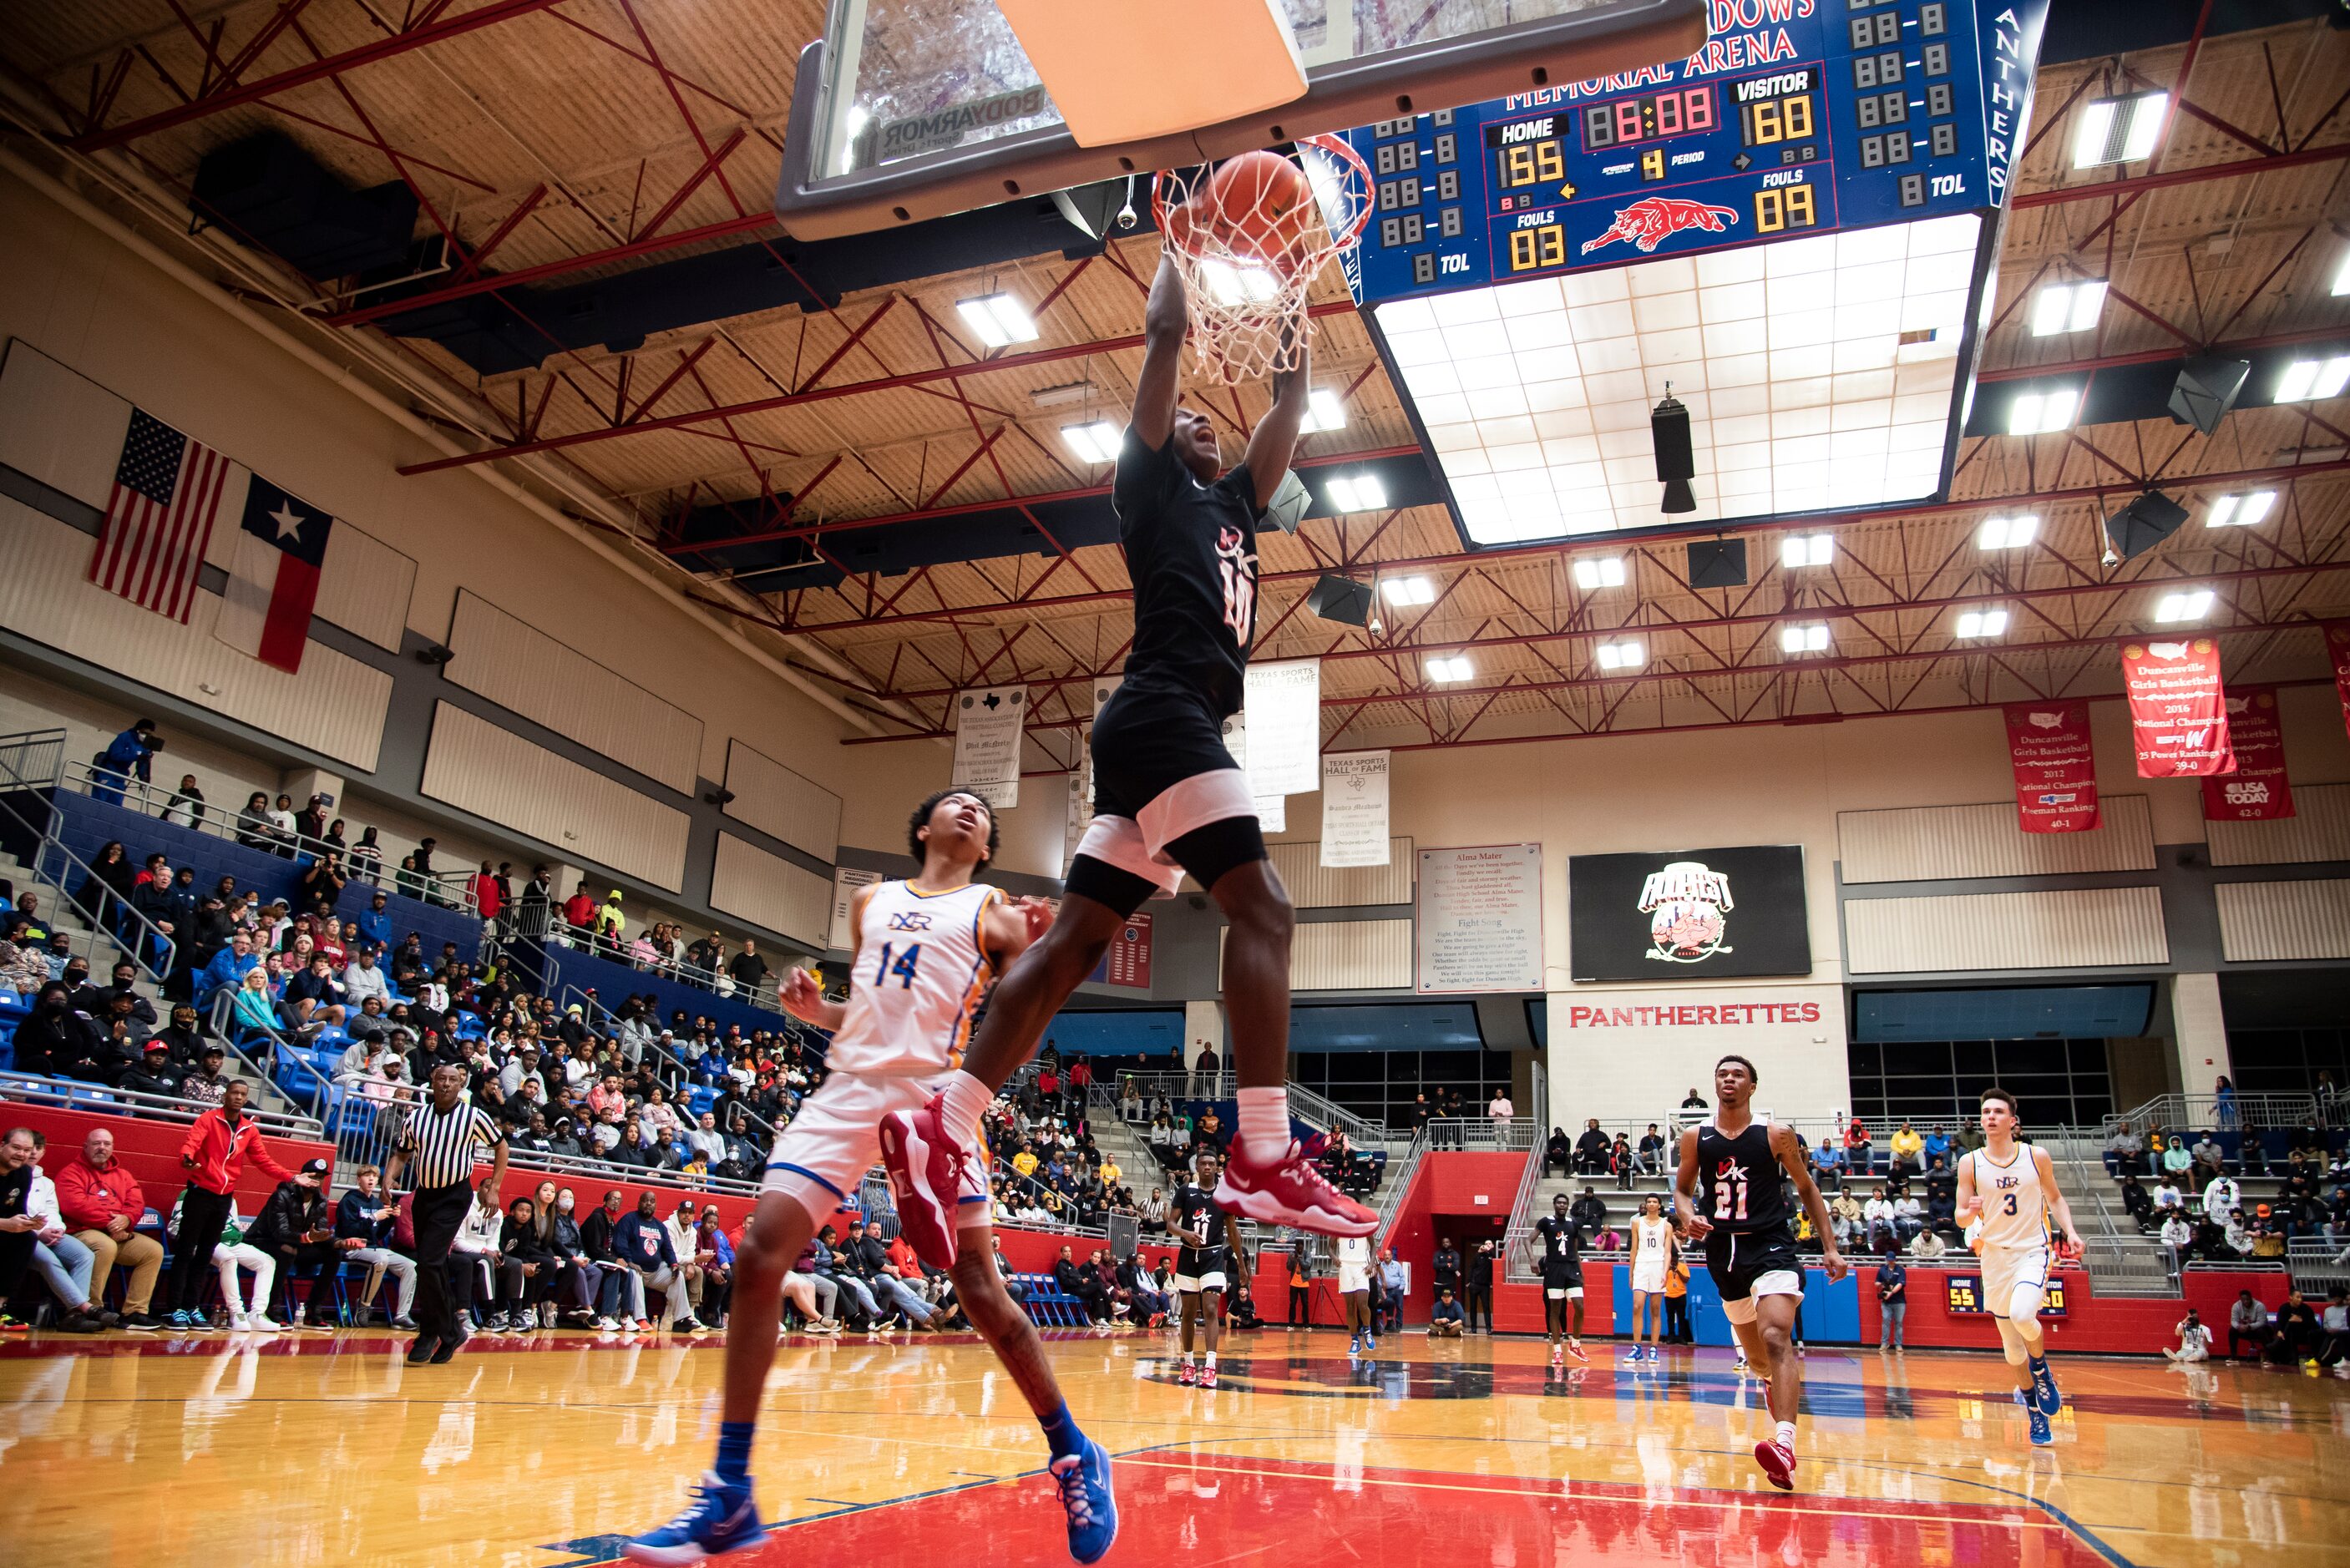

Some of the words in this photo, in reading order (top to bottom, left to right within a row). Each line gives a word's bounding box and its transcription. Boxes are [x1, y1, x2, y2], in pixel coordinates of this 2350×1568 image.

[1709, 0, 1815, 33] DOWS
[1684, 27, 1798, 78] ARENA
[1737, 72, 1809, 101] VISITOR
[1615, 86, 1713, 143] 6:08
[1754, 94, 1814, 145] 60
[1502, 118, 1553, 144] HOME
[1509, 141, 1564, 187] 55
[1643, 149, 1664, 180] 4
[1671, 151, 1705, 167] PERIOD
[1763, 169, 1804, 188] FOULS
[1931, 174, 1966, 197] TOL
[1755, 184, 1815, 233] 09
[1517, 210, 1555, 229] FOULS
[1512, 225, 1565, 271] 03
[1441, 253, 1470, 275] TOL
[1249, 670, 1278, 680] TEXAS
[1281, 667, 1314, 676] SPORTS
[2137, 663, 2206, 675] Duncanville
[1287, 674, 1316, 684] FAME
[2130, 680, 2158, 689] Girls
[2160, 675, 2218, 688] Basketball
[2165, 705, 2190, 714] 2016
[2135, 719, 2175, 728] National
[2176, 716, 2225, 727] Champion
[2021, 733, 2079, 744] Duncanville
[2014, 747, 2038, 756] Girls
[2040, 743, 2089, 756] Basketball
[2180, 750, 2220, 759] Rankings
[1360, 764, 1387, 772] FAME
[2175, 761, 2198, 771] 39-0
[2044, 770, 2064, 778] 2012
[2054, 780, 2095, 790] Champion
[2240, 781, 2267, 792] USA
[2225, 792, 2270, 804] TODAY
[2022, 806, 2056, 815] Freeman
[2239, 808, 2261, 817] 42-0
[2051, 820, 2070, 828] 40-1
[1458, 919, 1479, 928] Fight
[1481, 918, 1502, 928] Song
[874, 941, 921, 989] 14
[1570, 1002, 1821, 1028] PANTHERETTES
[1714, 1181, 1747, 1220] 21
[2003, 1194, 2017, 1216] 3
[1193, 1222, 1208, 1244] 11
[1349, 1239, 1355, 1249] 0
[1557, 1241, 1567, 1256] 4
[1647, 1238, 1657, 1247] 10
[1950, 1288, 1974, 1306] 55
